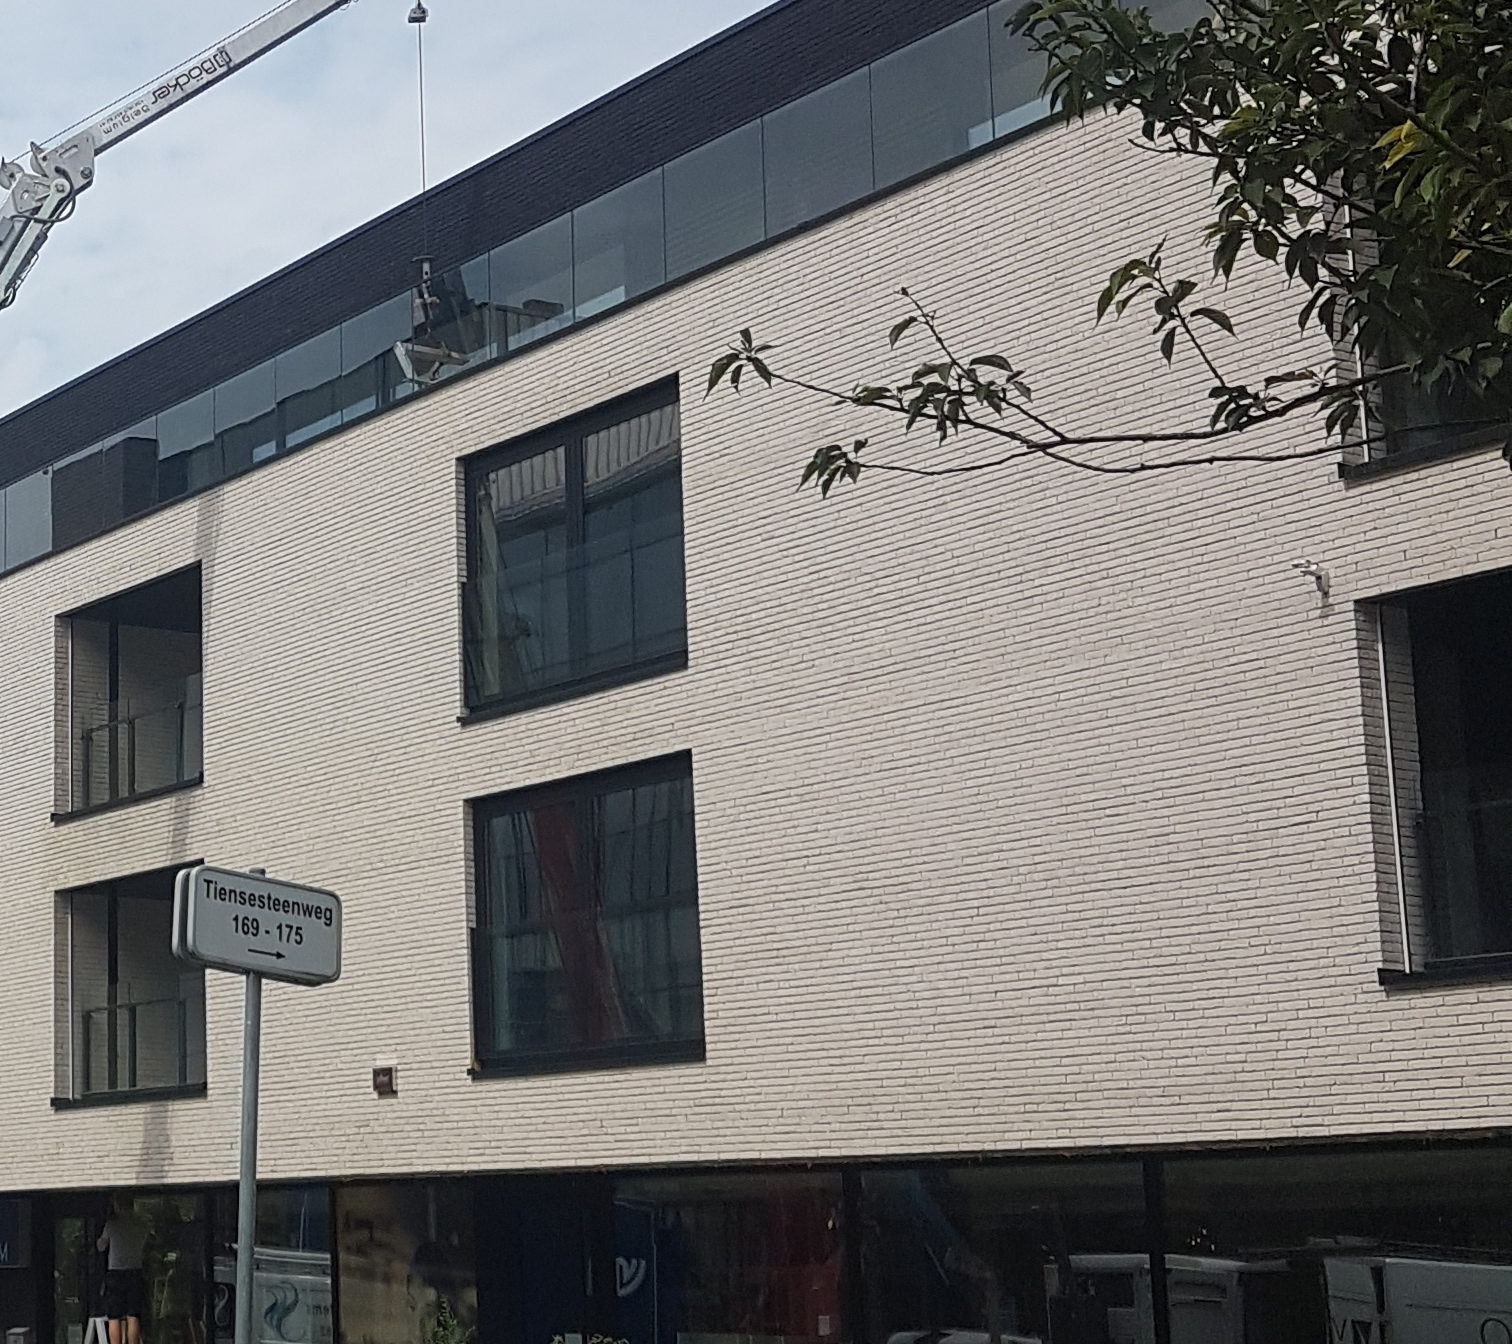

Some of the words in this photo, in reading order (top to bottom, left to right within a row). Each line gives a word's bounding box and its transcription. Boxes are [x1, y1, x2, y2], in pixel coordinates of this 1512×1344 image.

[151, 58, 217, 104] Böcker
[203, 878, 333, 927] Tiensesteenweg
[232, 914, 260, 937] 169
[276, 922, 304, 945] 175
